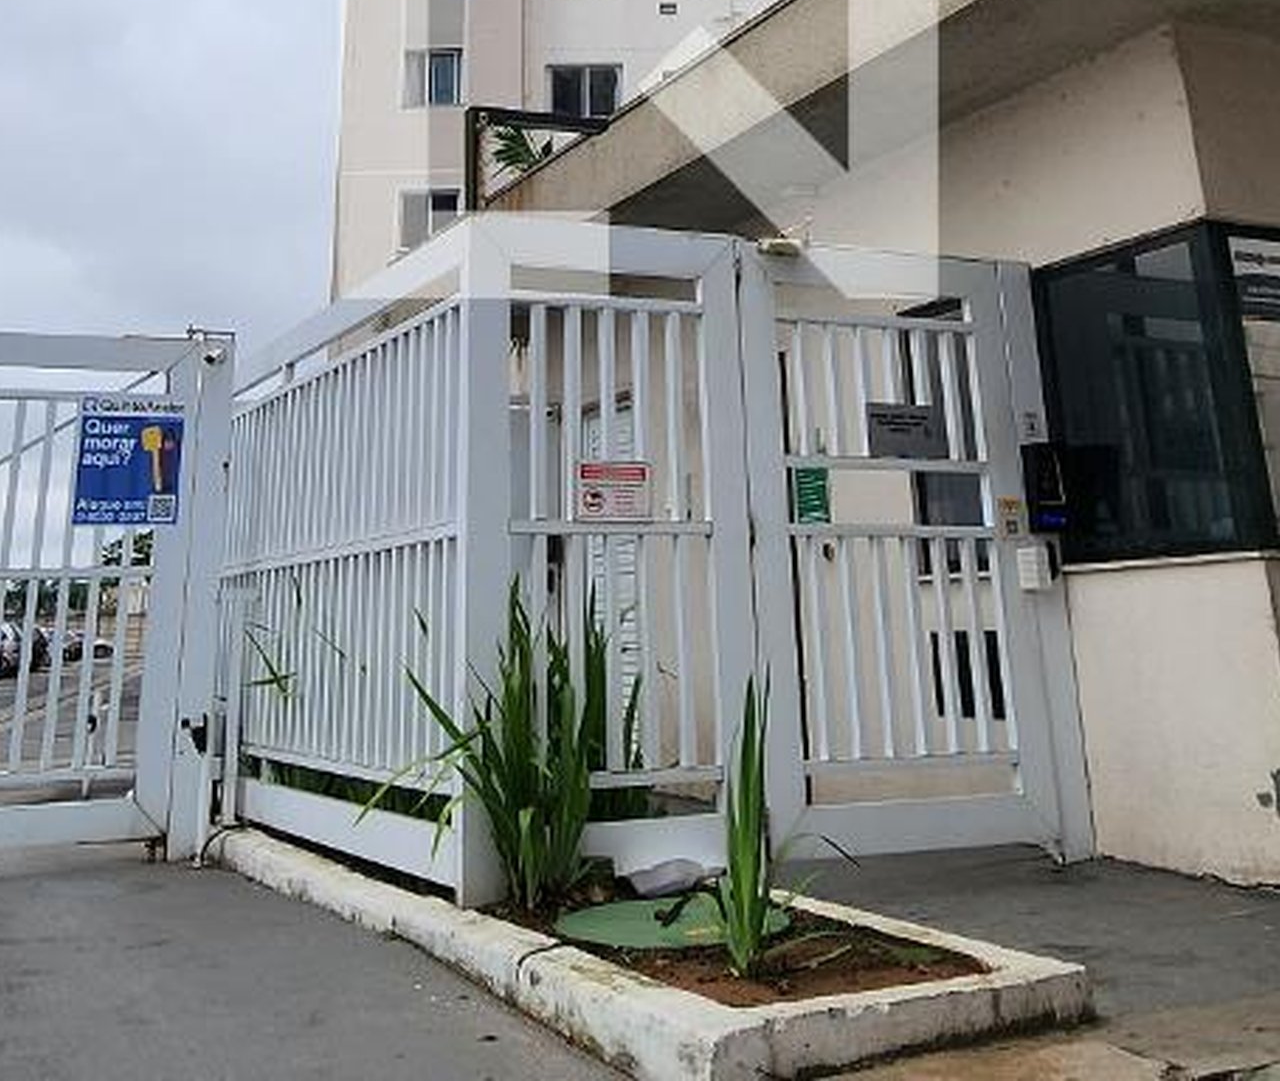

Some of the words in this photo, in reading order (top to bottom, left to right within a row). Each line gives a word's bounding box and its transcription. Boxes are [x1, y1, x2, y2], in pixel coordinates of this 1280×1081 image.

[85, 419, 131, 434] Quer
[83, 438, 138, 450] morar
[82, 450, 132, 468] aqui?
